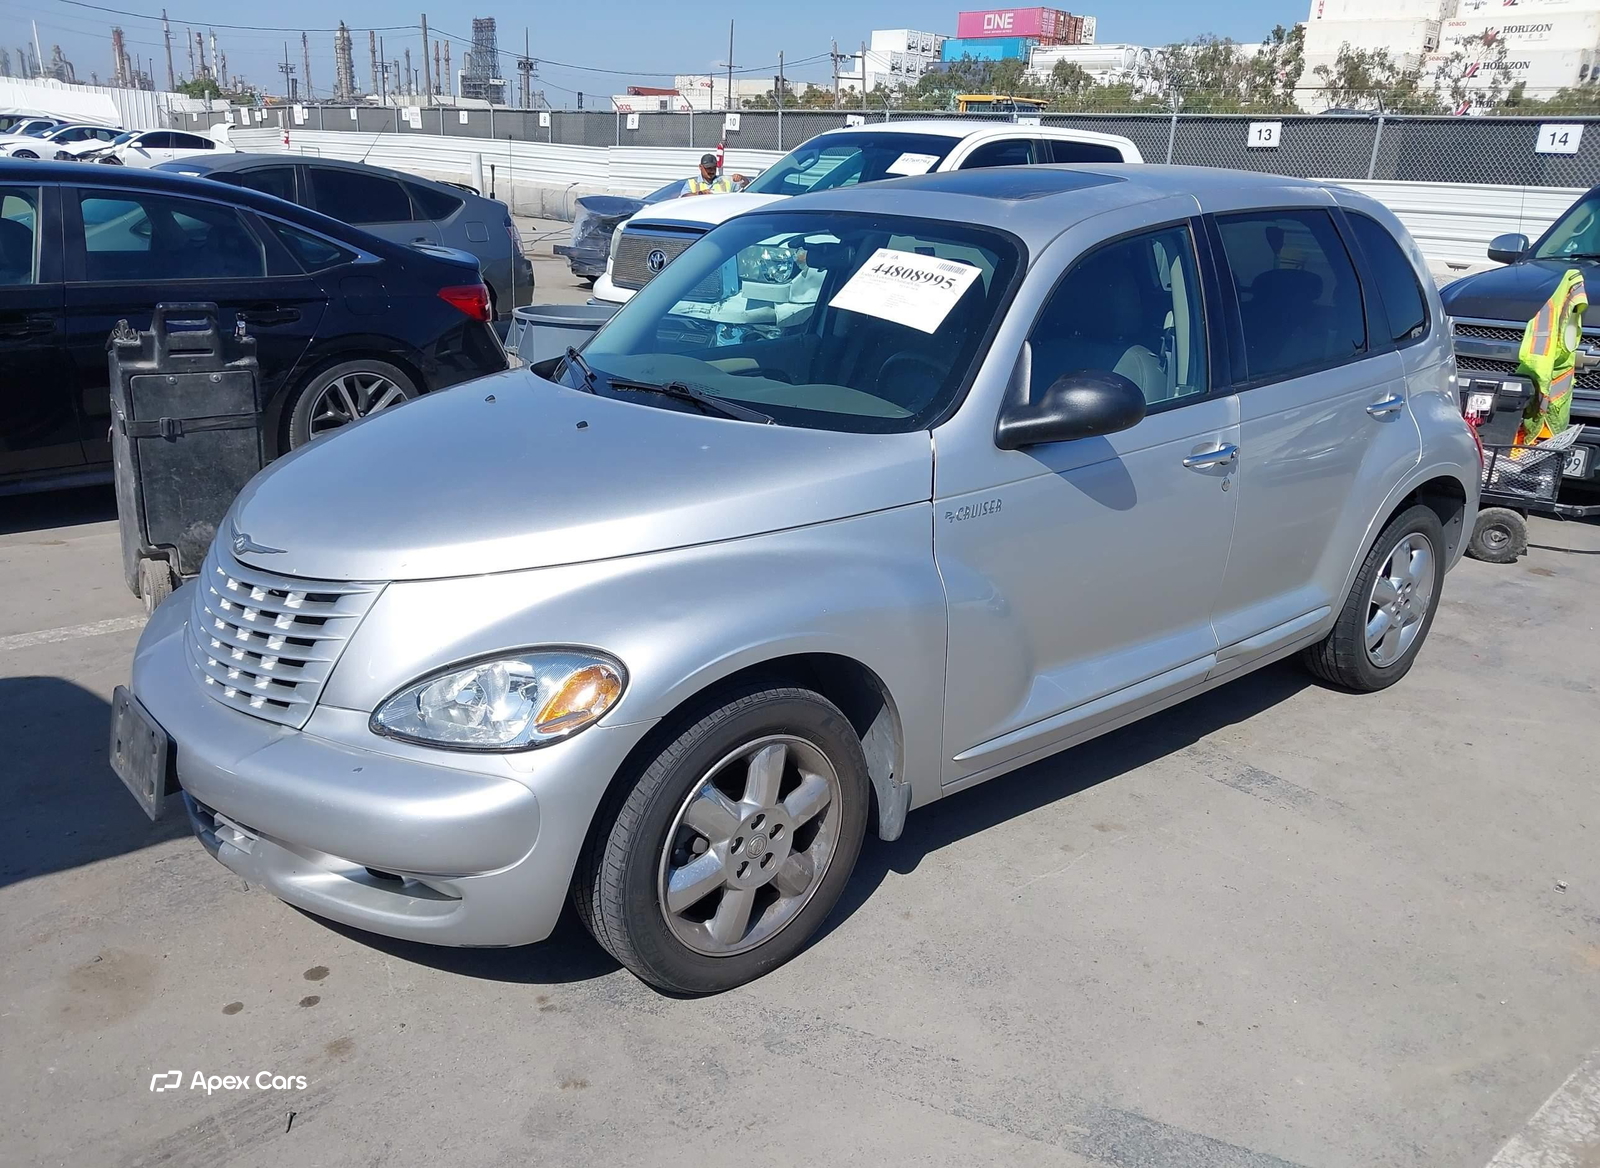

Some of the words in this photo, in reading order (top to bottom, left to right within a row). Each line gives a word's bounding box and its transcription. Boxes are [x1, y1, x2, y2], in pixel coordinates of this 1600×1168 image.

[983, 13, 1014, 30] ONE
[1502, 24, 1553, 34] HORIZON
[630, 117, 635, 126] 9
[729, 118, 737, 127] 10
[1256, 128, 1272, 141] 13
[1549, 131, 1569, 146] 14
[871, 263, 956, 290] 44808995
[944, 511, 955, 524] PT
[956, 499, 1003, 522] CRUISER
